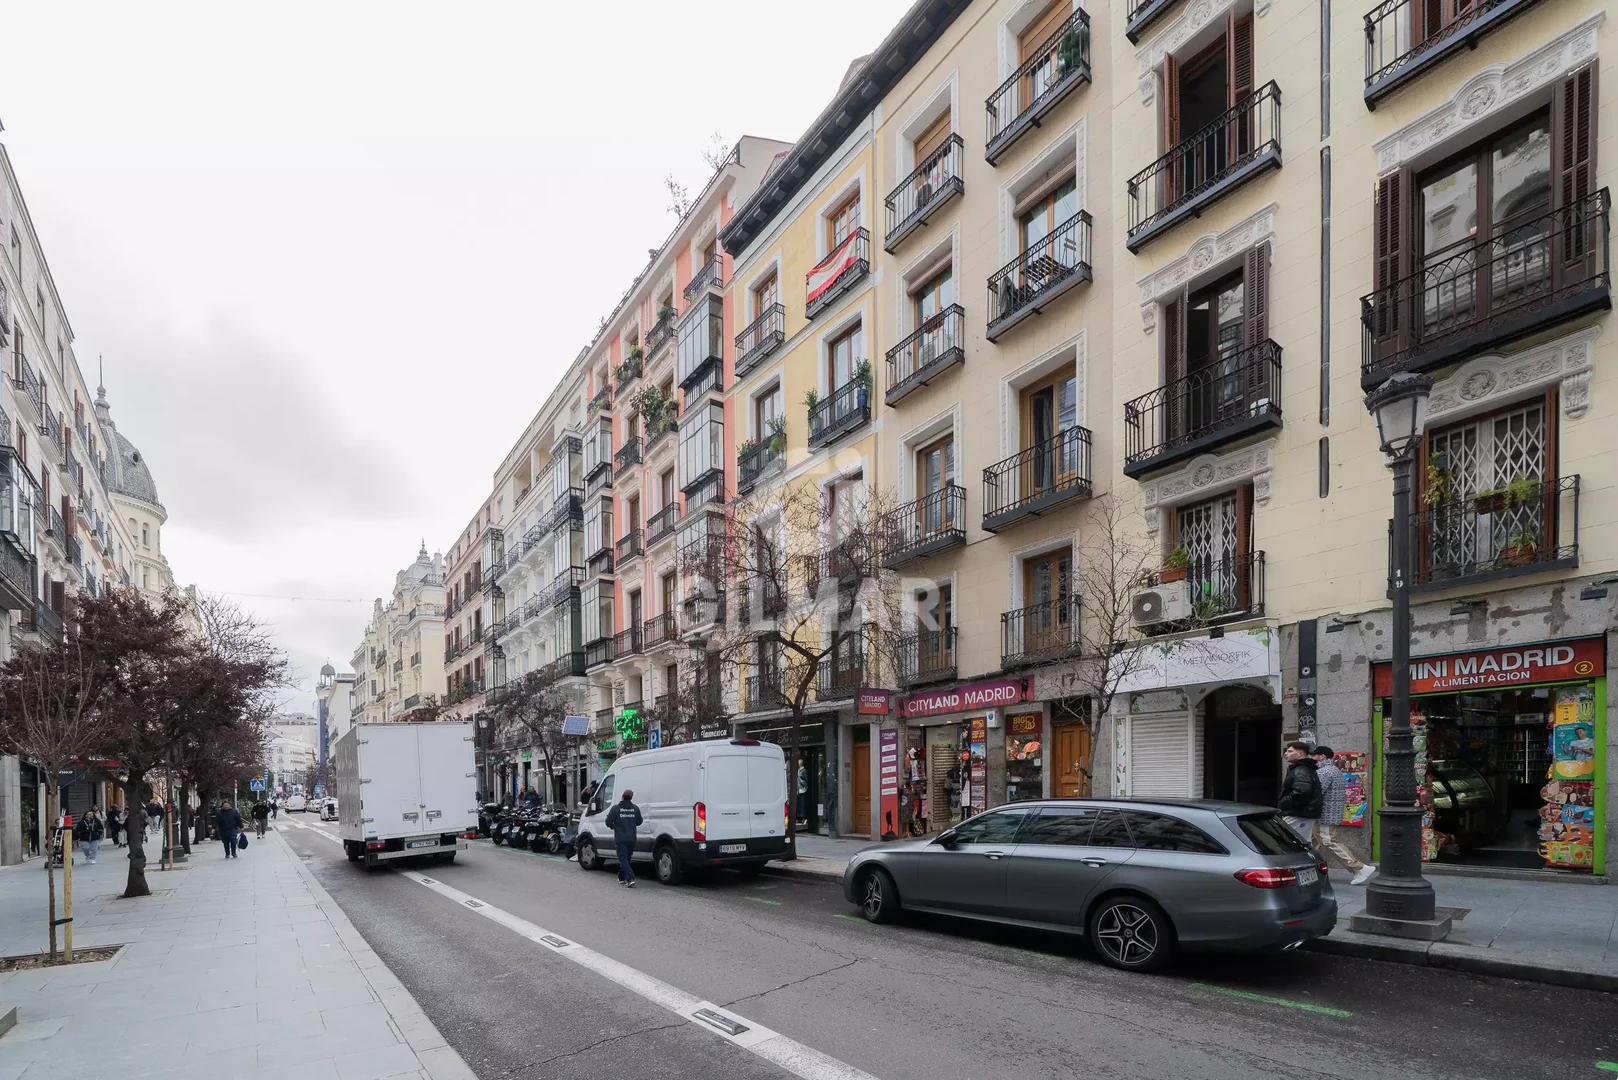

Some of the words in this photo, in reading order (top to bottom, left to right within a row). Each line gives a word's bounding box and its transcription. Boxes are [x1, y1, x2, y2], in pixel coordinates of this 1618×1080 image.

[1454, 646, 1575, 676] MADRID
[1580, 664, 1588, 672] 2
[1432, 671, 1530, 688] ALIMENTACION
[861, 695, 886, 703] CITYLAND
[908, 694, 960, 712] CITYLAND
[964, 686, 1016, 705] MADRID
[1013, 716, 1025, 725] BIG
[650, 732, 658, 749] P
